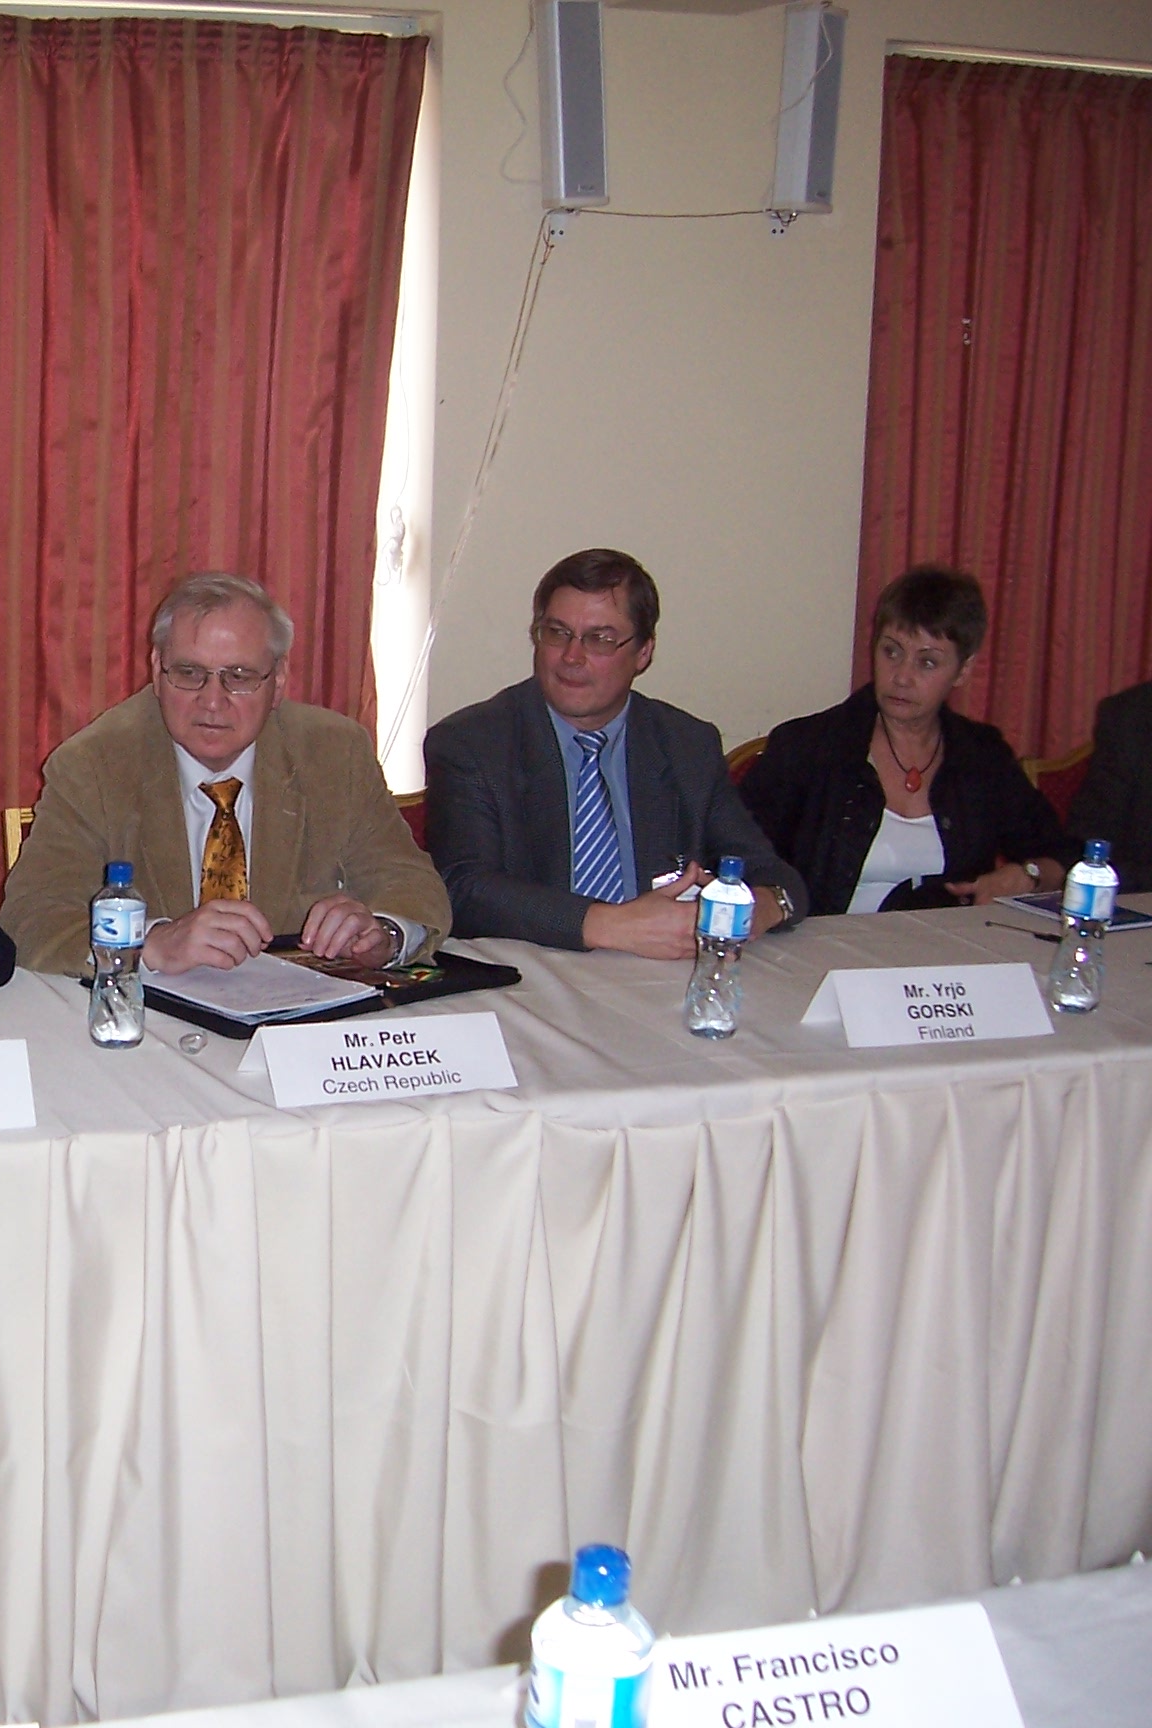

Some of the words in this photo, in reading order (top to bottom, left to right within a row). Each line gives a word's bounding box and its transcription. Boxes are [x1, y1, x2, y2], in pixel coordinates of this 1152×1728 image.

[903, 984, 929, 998] Mr.
[907, 1003, 974, 1019] GORSKI
[344, 1033, 374, 1048] Mr.
[379, 1030, 416, 1046] Petr
[917, 1024, 975, 1040] Finland
[331, 1049, 441, 1071] HLAVACEK
[322, 1076, 379, 1094] Czech
[384, 1069, 462, 1091] Republic
[668, 1661, 723, 1690] Mr.
[732, 1643, 900, 1683] Francisco
[721, 1686, 871, 1728] CASTRO
